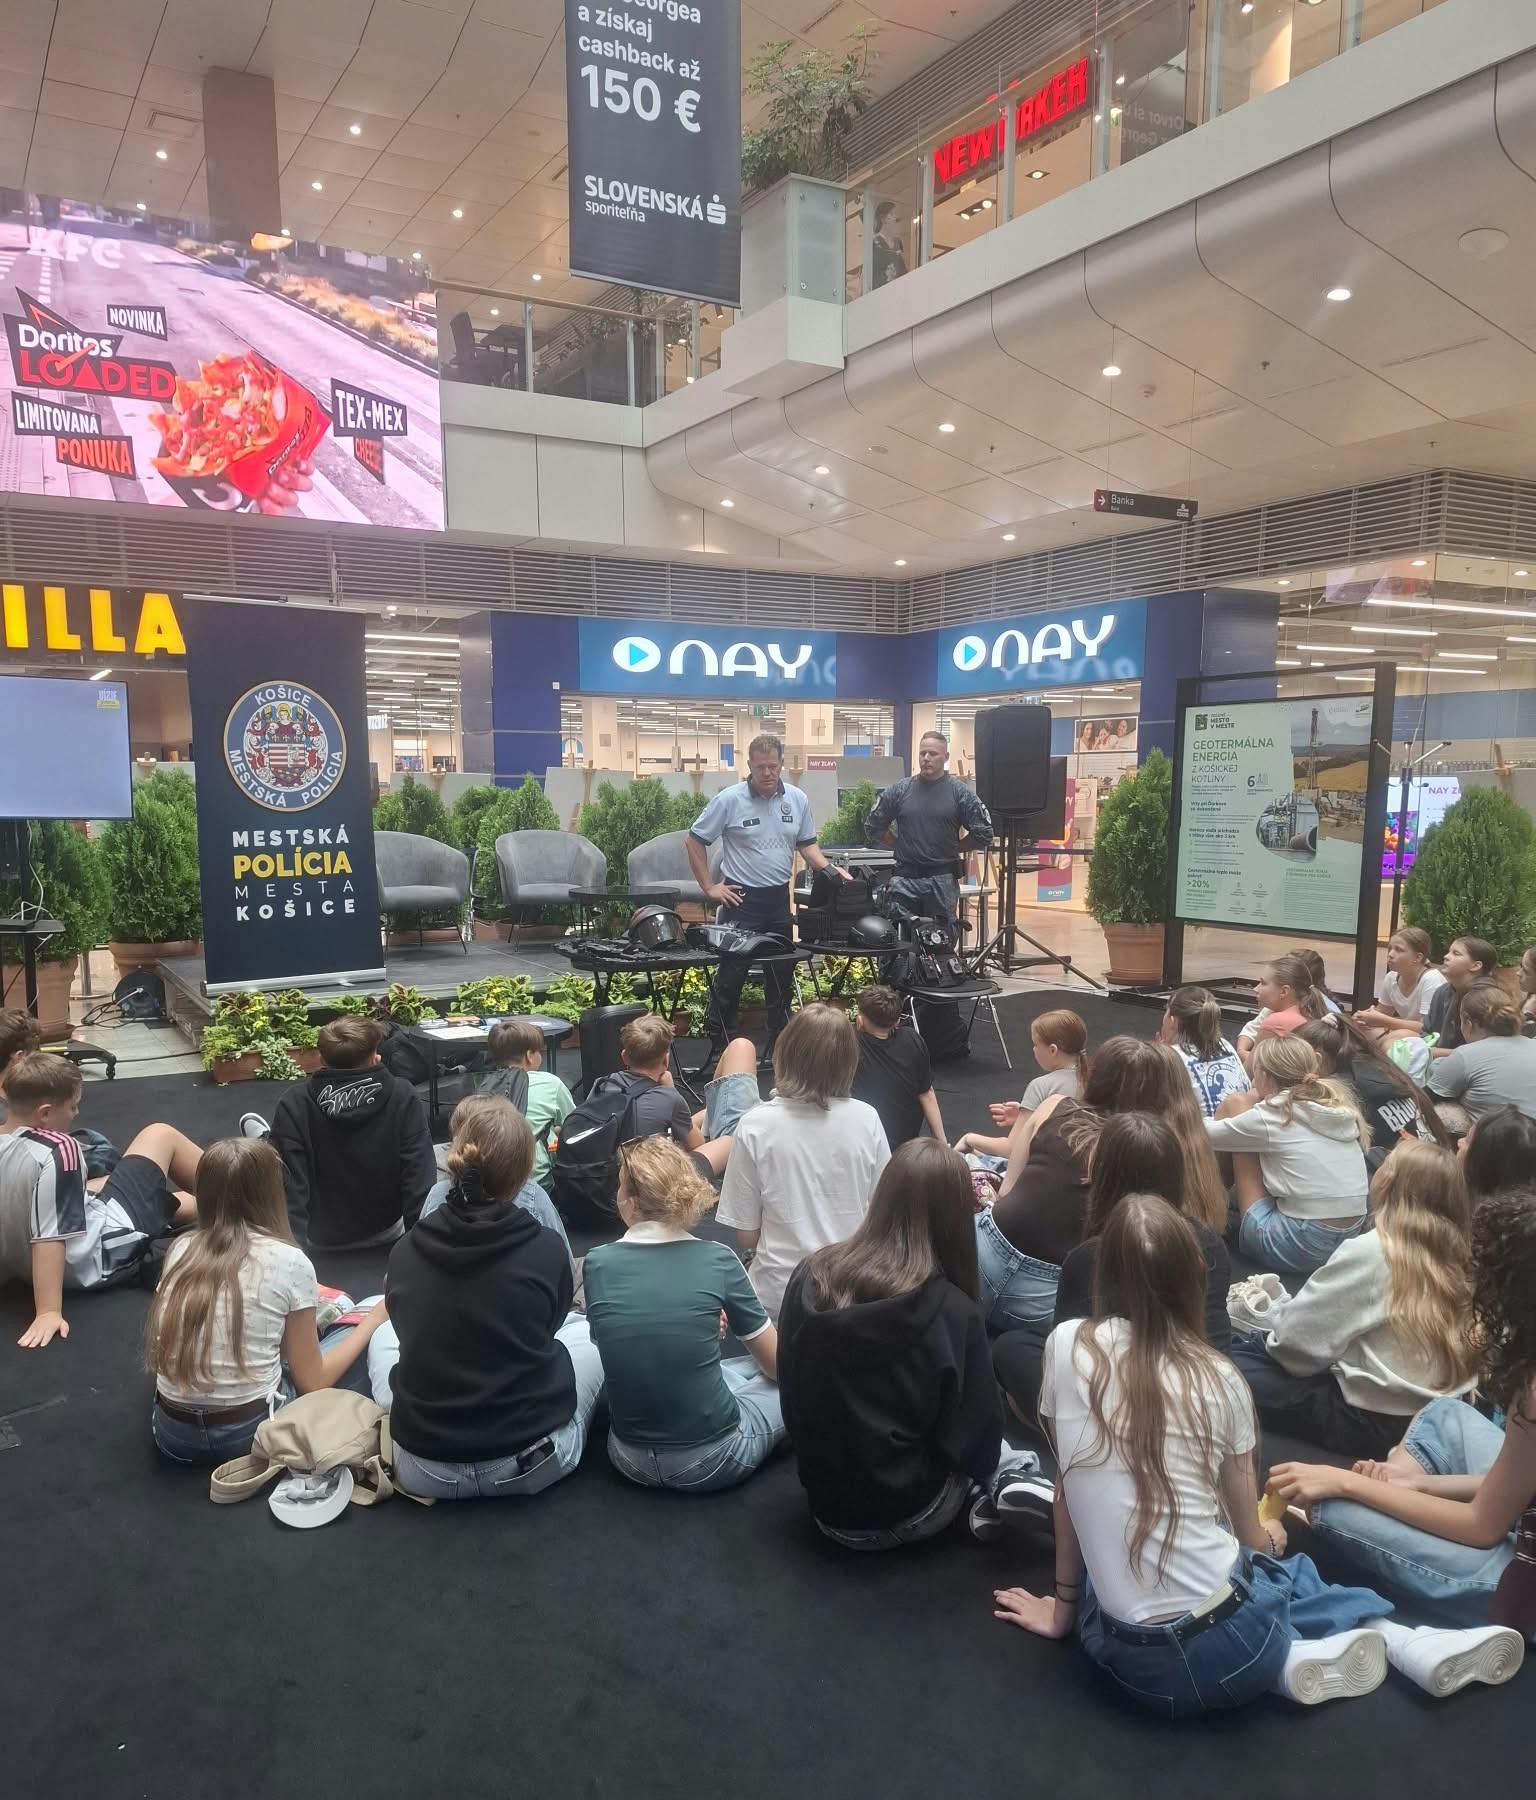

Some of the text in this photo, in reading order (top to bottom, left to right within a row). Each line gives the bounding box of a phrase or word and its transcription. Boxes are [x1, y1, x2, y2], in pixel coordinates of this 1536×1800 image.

[578, 5, 653, 43] a získaj
[623, 0, 701, 24] orgea
[578, 35, 701, 81] cashback až
[580, 64, 701, 133] 150 €
[934, 121, 996, 183] NEW
[584, 175, 704, 221] SLOVENSKÁ
[585, 200, 646, 223] sporiteľňa
[108, 306, 166, 336] NOVINKA
[18, 323, 114, 358] Doritos
[19, 349, 176, 399] LOADED
[15, 399, 99, 435] LIMITOVANÁ
[335, 389, 404, 432] TEX-MEX
[57, 438, 133, 476] PONUKA
[1111, 494, 1135, 506] Banka
[991, 614, 1116, 668] NAY
[669, 639, 813, 679] NAY
[254, 685, 312, 707] KOŠICE
[1192, 751, 1239, 762] ENERGIA
[1193, 736, 1274, 750] GEOTERMÁLNA
[229, 749, 343, 807] MESTSKÁ POLÍCIA
[1191, 774, 1226, 783] KOTLINY
[1192, 763, 1238, 773] Z KOŠICKEJ
[1247, 775, 1256, 788] 6
[1428, 786, 1449, 794] NAY
[233, 823, 350, 848] MESTSKÁ
[233, 848, 353, 880] POLÍCIA
[235, 880, 355, 900] MESTA
[236, 898, 356, 922] KOŠICE
